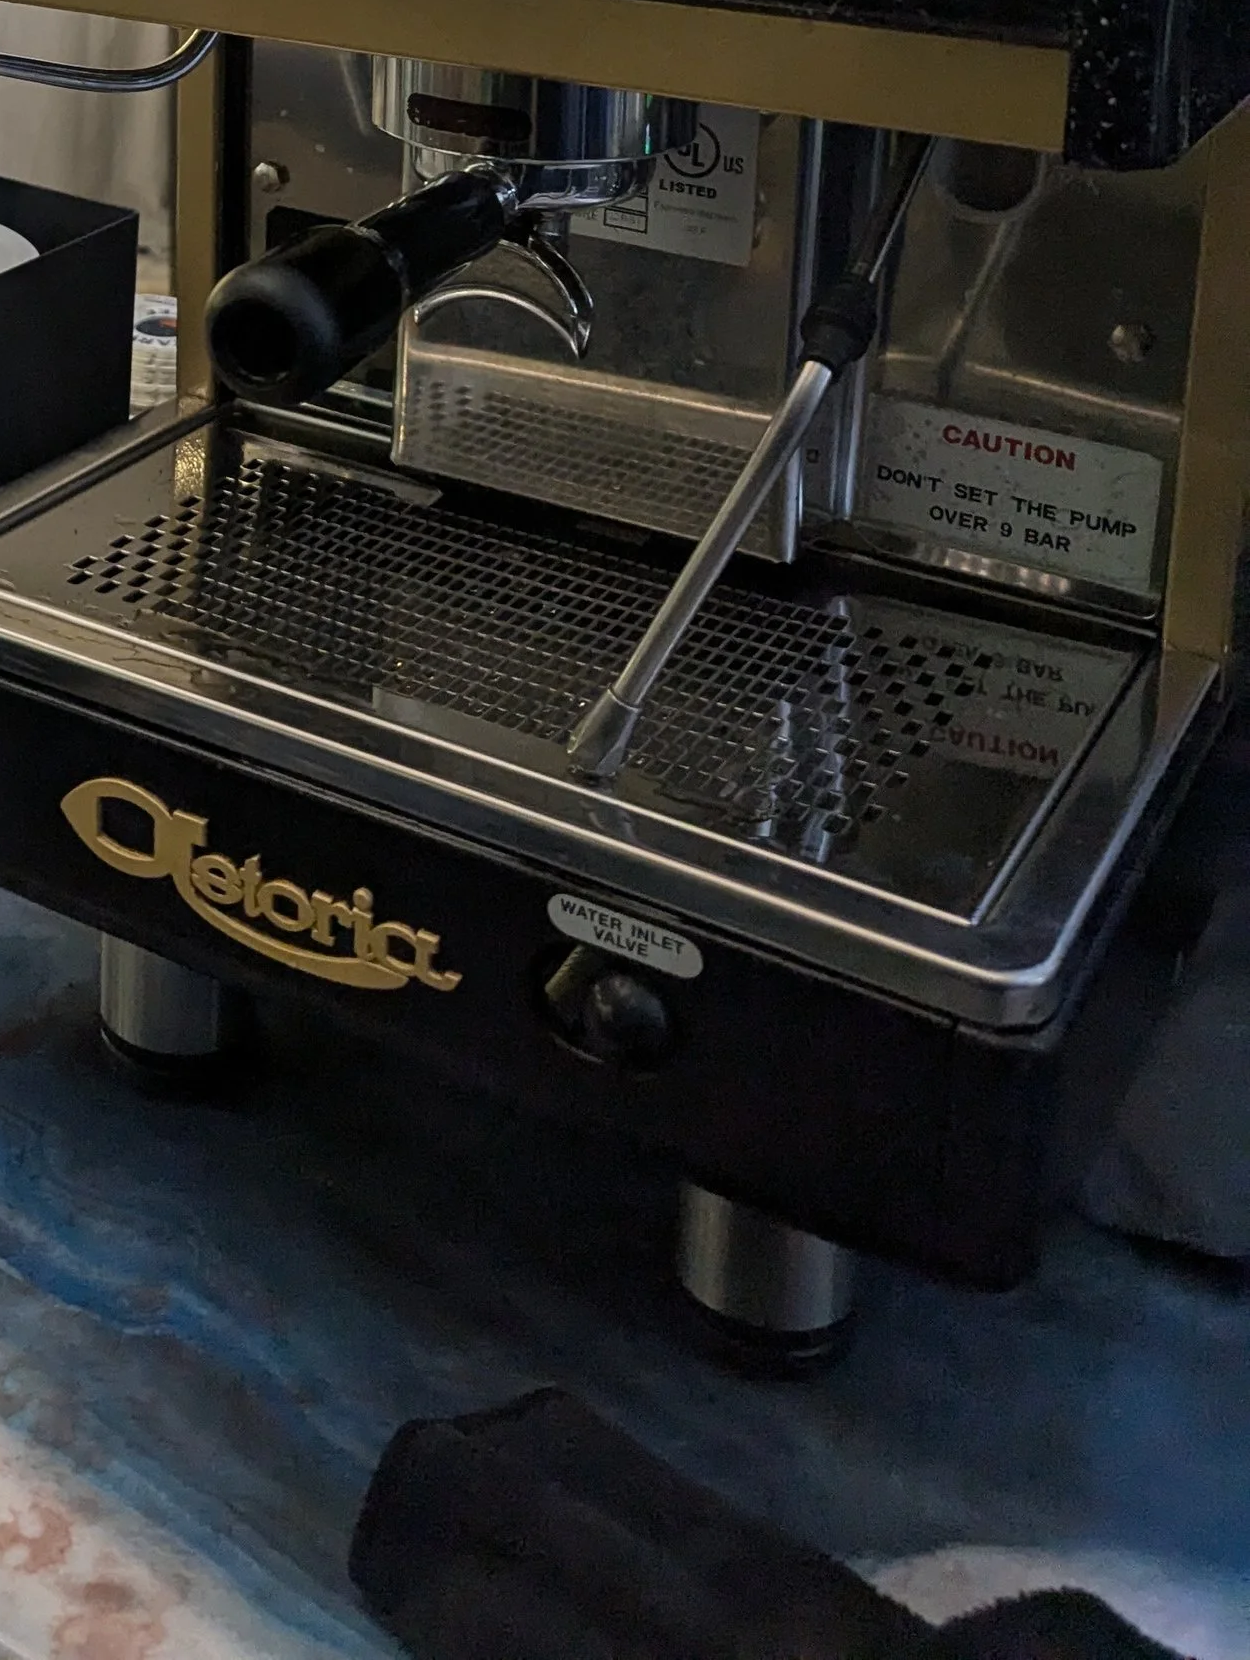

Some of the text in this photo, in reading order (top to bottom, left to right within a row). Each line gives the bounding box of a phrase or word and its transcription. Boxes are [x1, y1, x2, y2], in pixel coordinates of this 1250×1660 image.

[659, 178, 718, 199] LISTED
[723, 155, 744, 175] US
[942, 424, 1076, 471] CAUTION
[877, 464, 1137, 538] DON'T SET THE PUMP
[929, 505, 1071, 553] OVER 9 BAR
[561, 898, 686, 955] WATER INLET
[593, 925, 649, 957] VALVE
